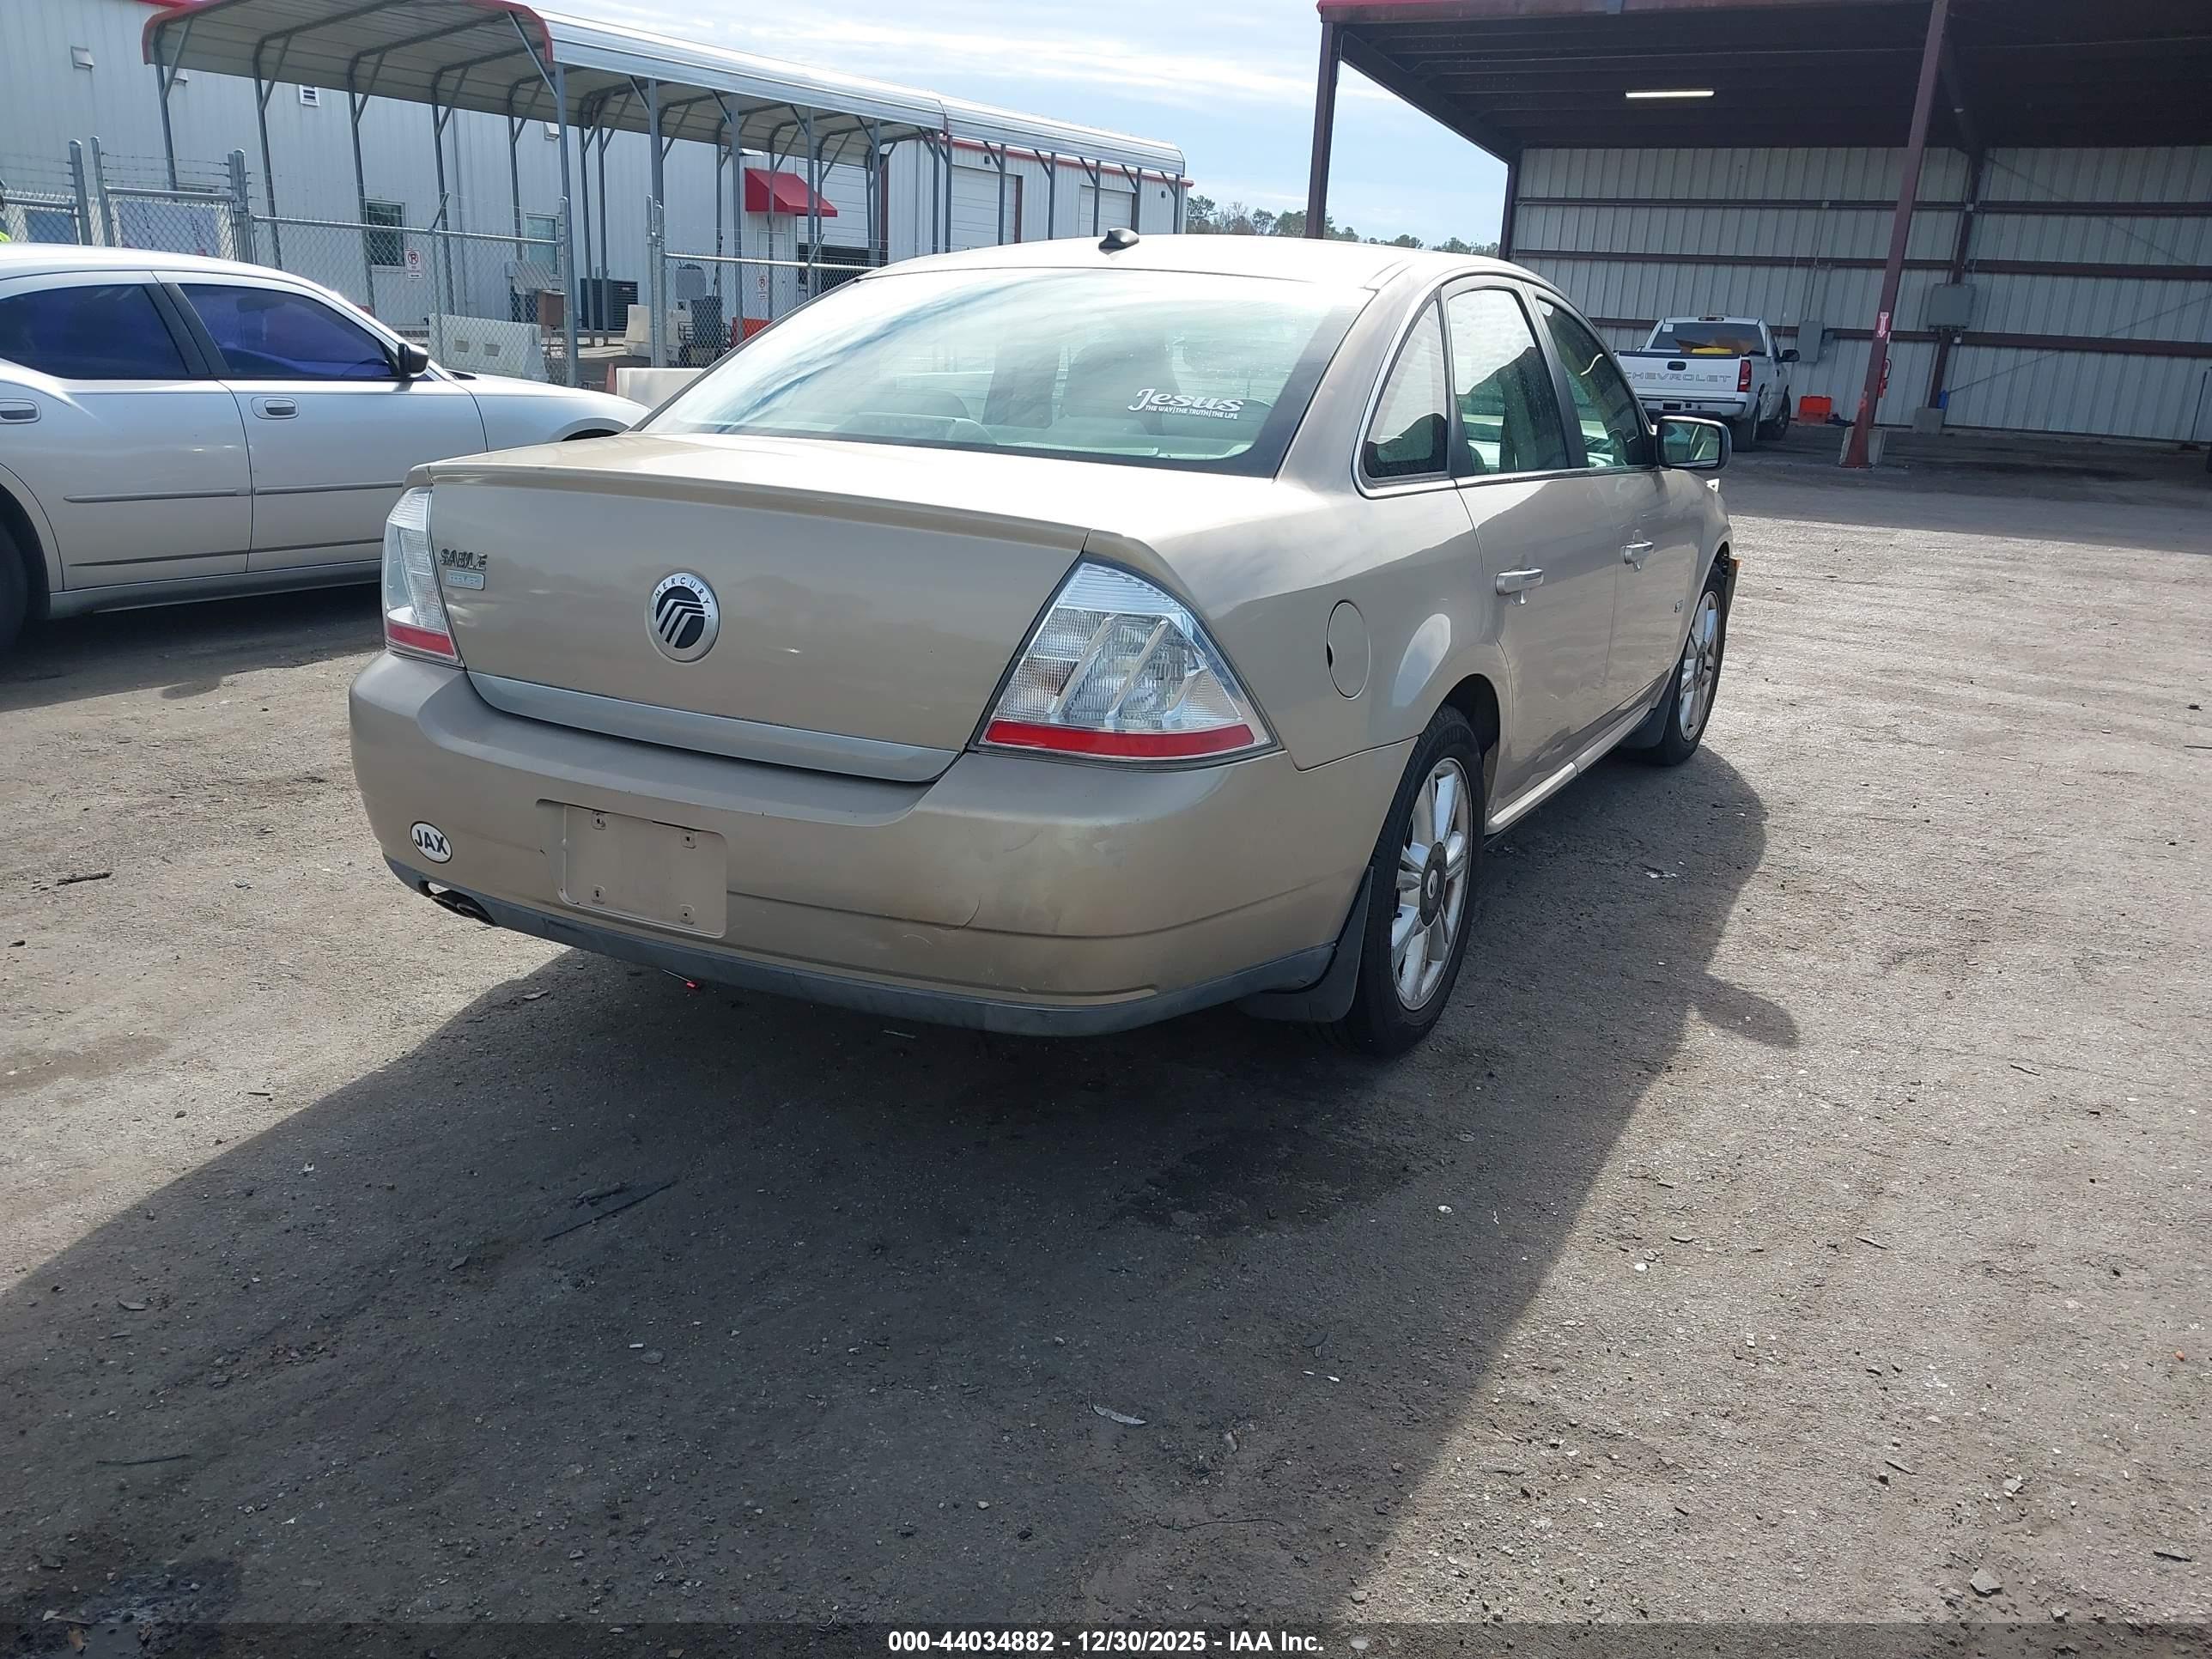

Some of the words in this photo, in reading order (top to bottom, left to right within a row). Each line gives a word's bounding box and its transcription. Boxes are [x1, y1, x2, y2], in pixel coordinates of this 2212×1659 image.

[1127, 388, 1244, 411] Jesus
[440, 548, 488, 571] SABLE
[655, 577, 711, 605] MERCURY
[415, 829, 449, 856] JAX
